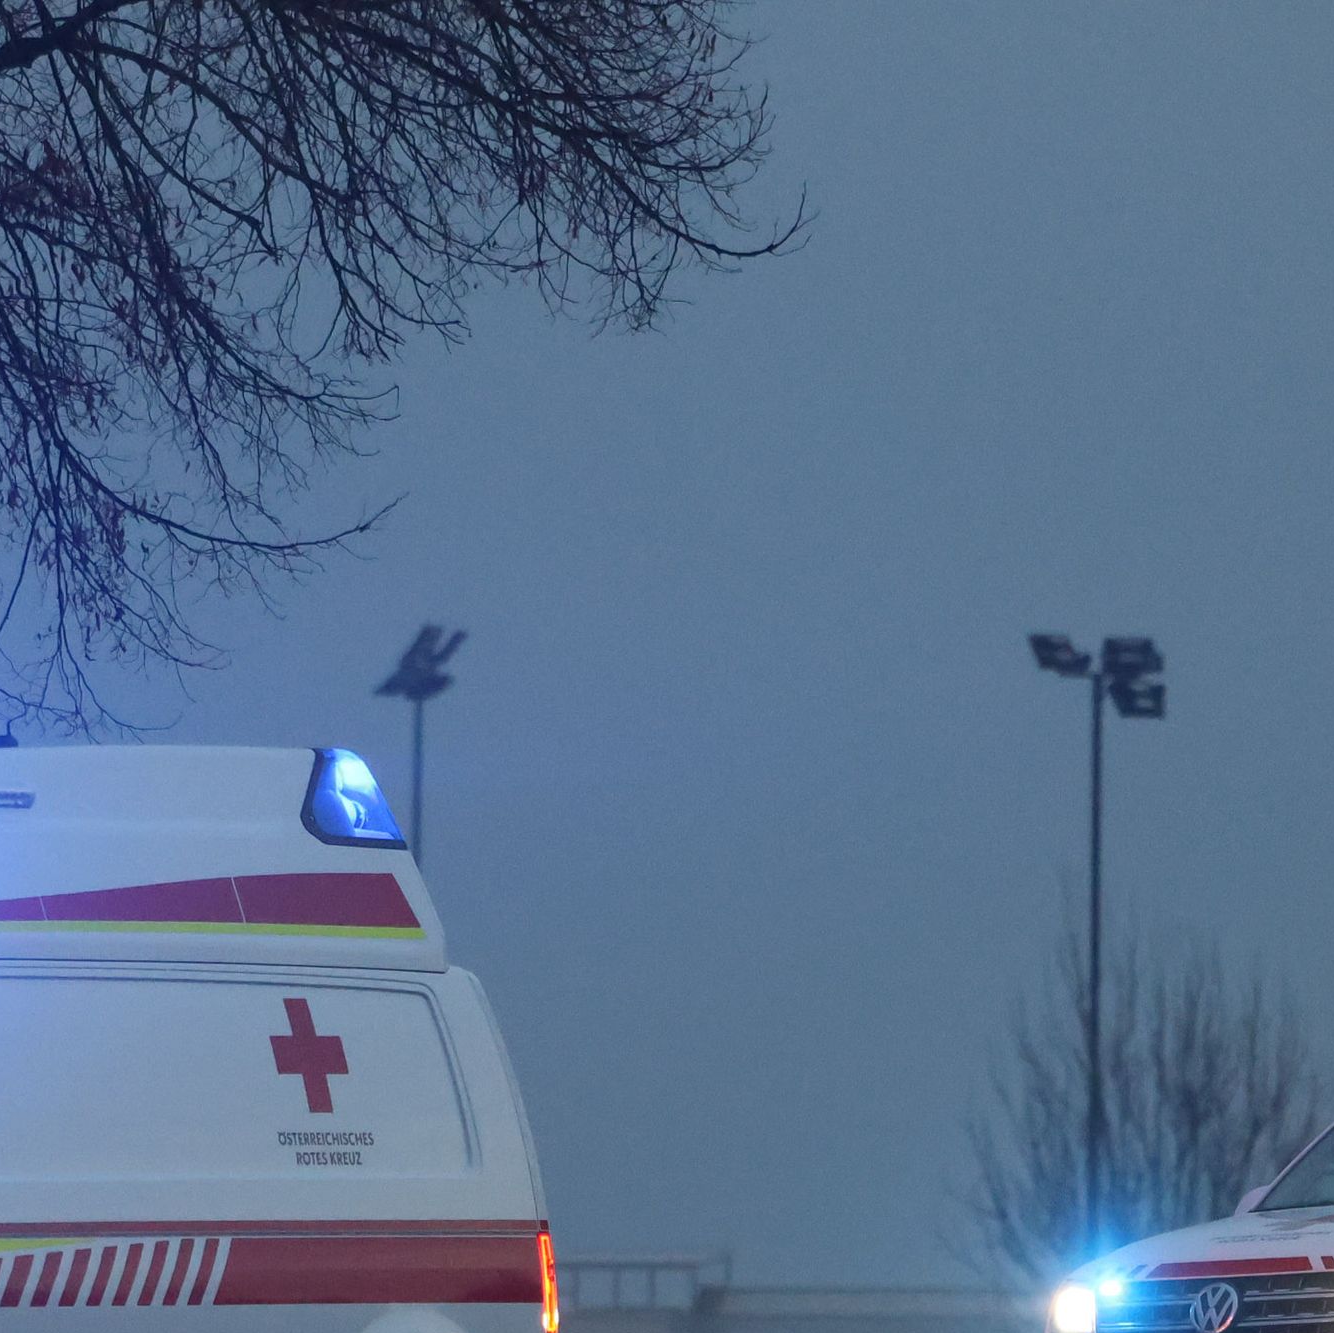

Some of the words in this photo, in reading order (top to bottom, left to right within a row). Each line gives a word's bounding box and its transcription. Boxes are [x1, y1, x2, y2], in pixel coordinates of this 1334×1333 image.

[277, 1131, 375, 1146] ÖSTERREICHISCHES
[296, 1151, 328, 1166] ROTES
[329, 1151, 363, 1166] KREUZ
